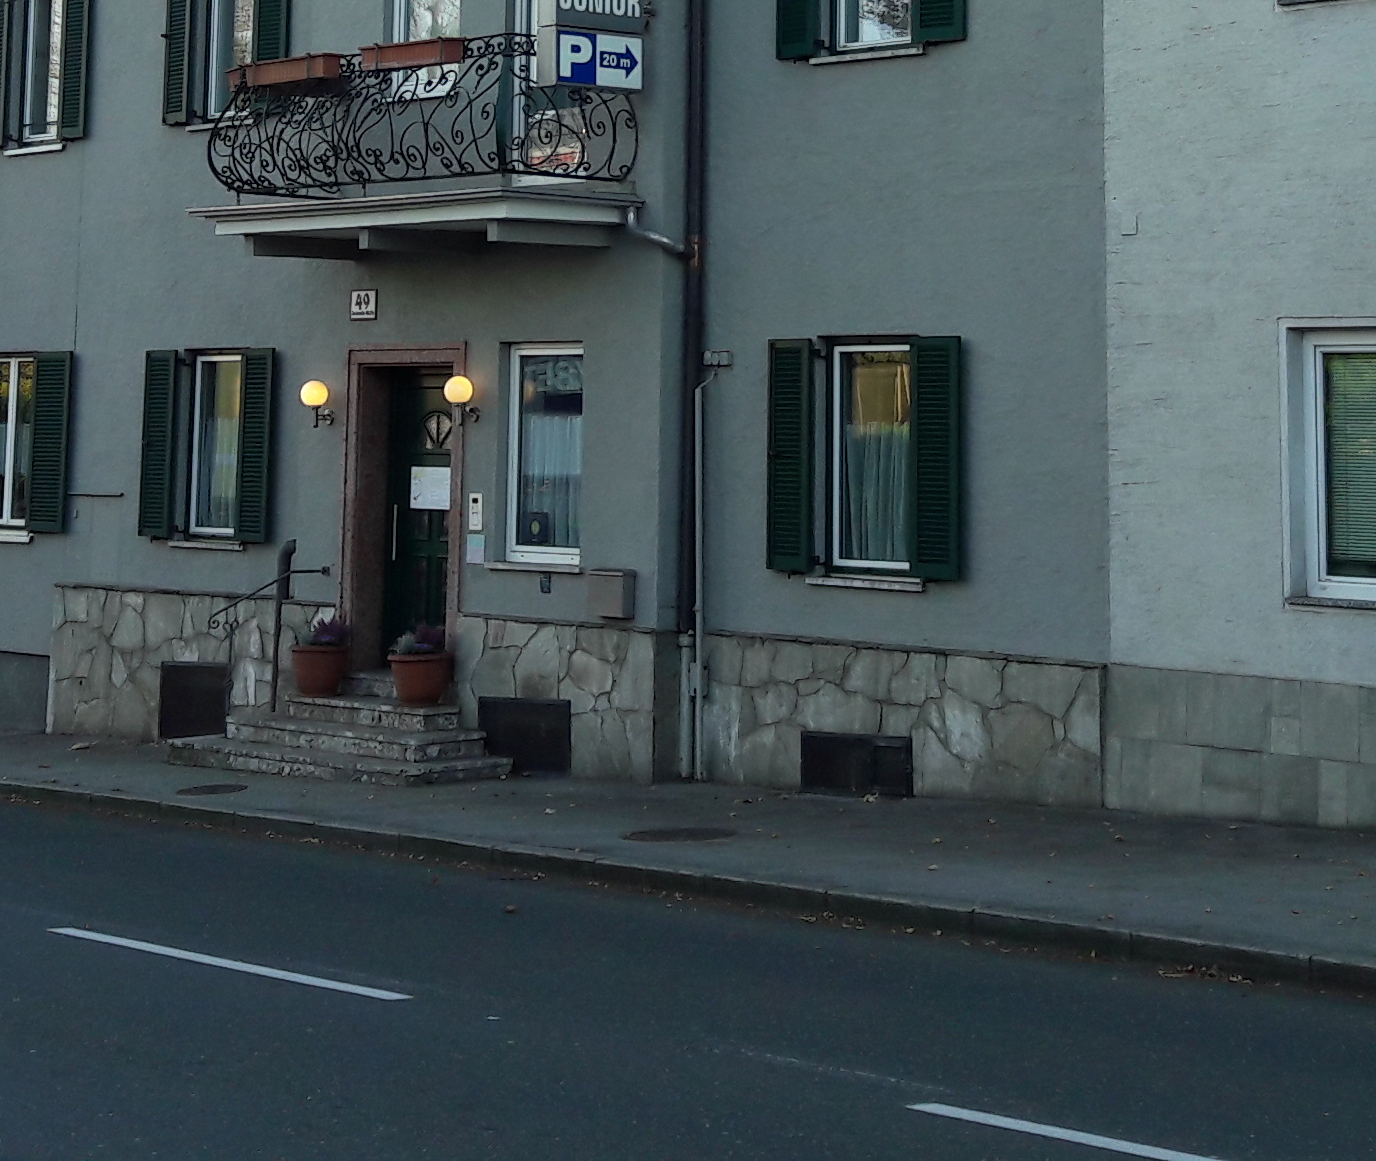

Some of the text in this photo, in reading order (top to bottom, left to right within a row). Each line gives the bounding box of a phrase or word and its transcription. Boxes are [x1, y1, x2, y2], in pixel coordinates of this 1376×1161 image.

[558, 32, 593, 79] P
[602, 53, 631, 68] 20 m
[354, 292, 371, 311] 49
